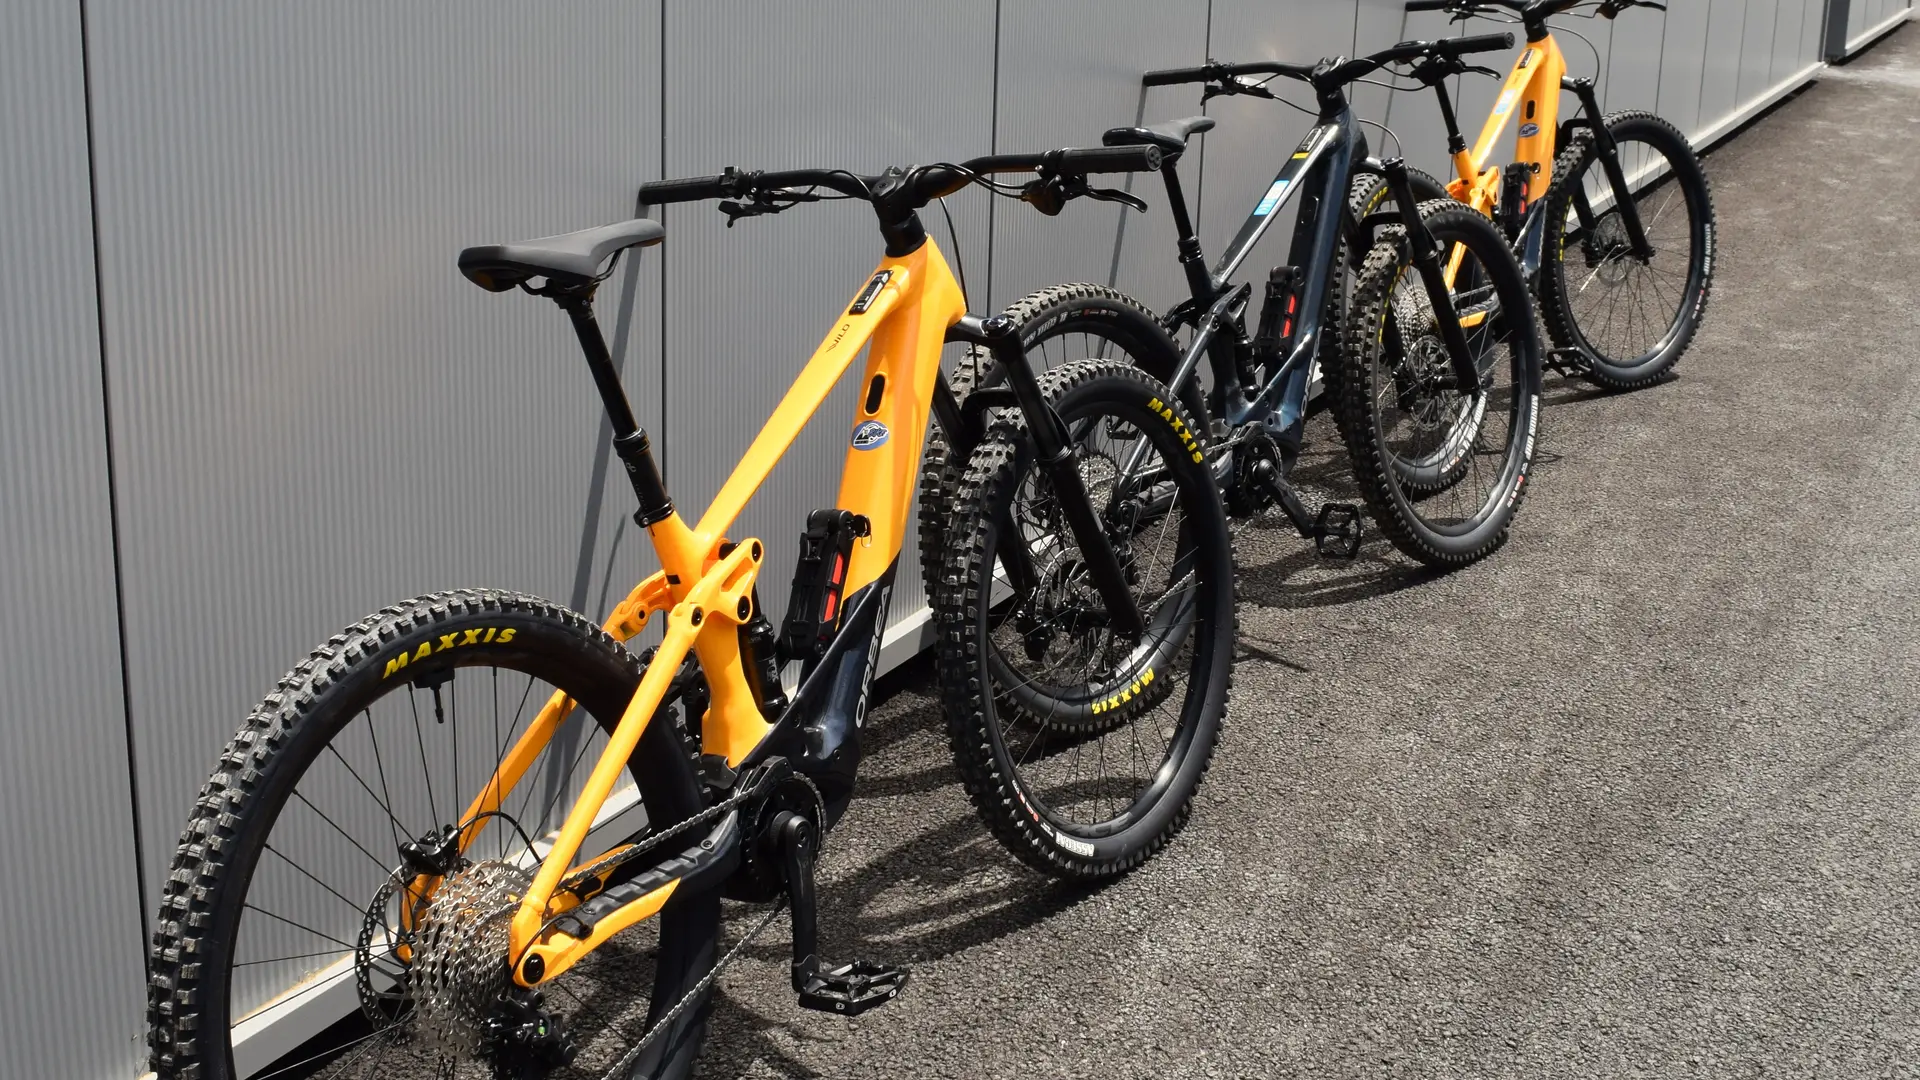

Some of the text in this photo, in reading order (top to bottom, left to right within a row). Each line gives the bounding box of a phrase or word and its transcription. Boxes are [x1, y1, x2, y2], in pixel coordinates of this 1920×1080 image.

[1147, 397, 1204, 464] MAXXIS
[1528, 394, 1539, 435] MINION
[382, 627, 517, 679] MAXXIS
[855, 585, 891, 728] ORBEA
[1091, 667, 1155, 715] MAXXIS
